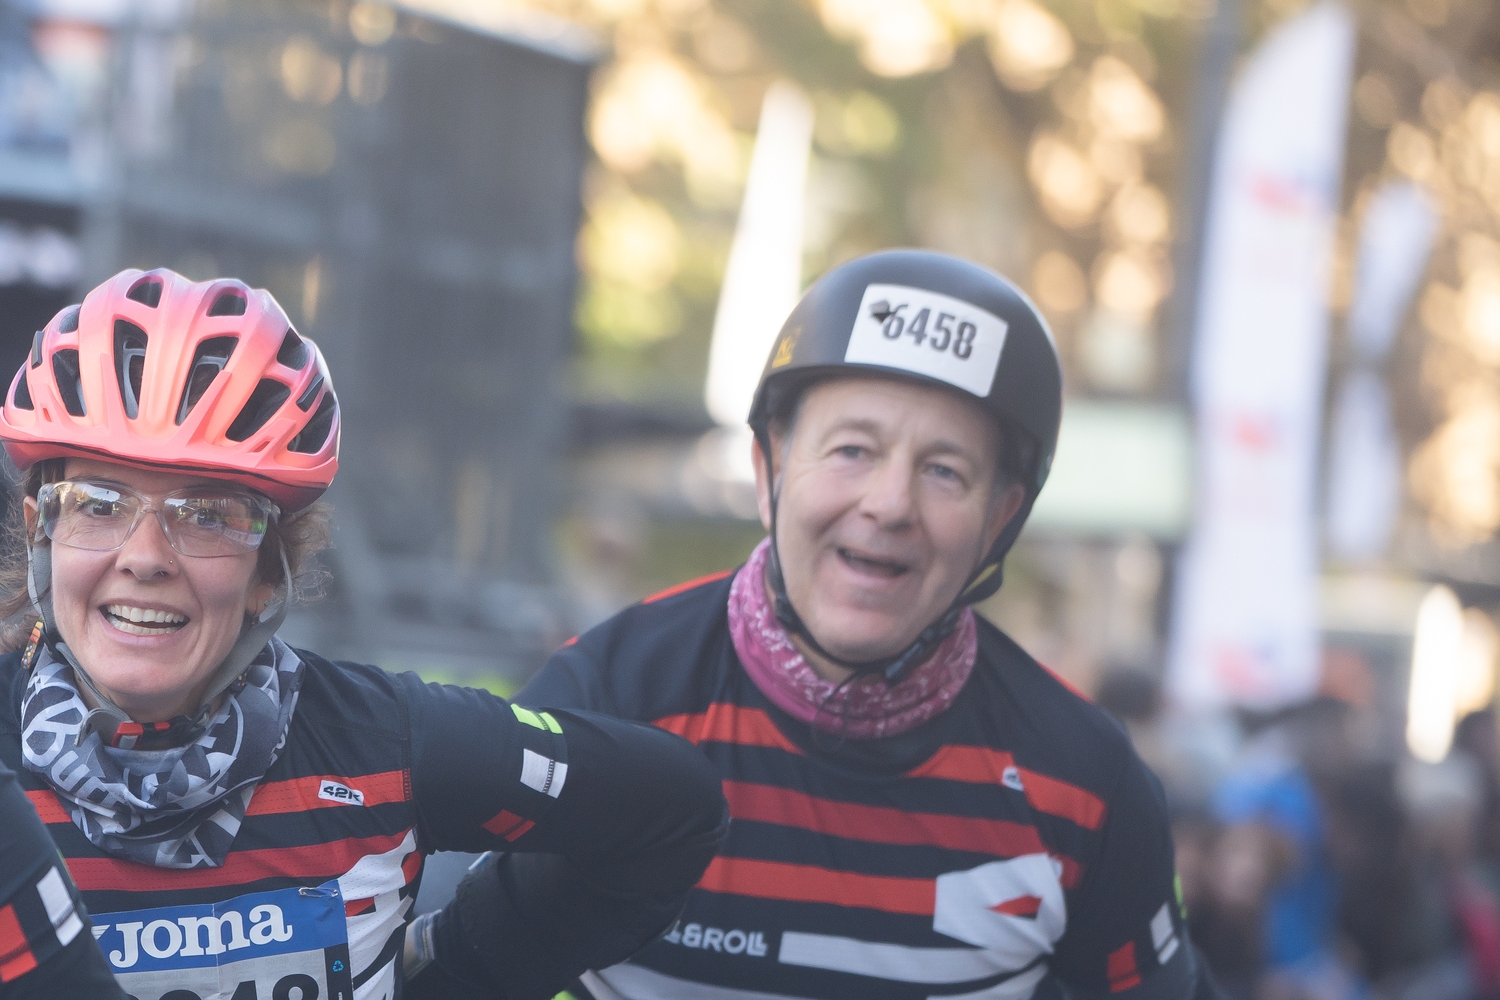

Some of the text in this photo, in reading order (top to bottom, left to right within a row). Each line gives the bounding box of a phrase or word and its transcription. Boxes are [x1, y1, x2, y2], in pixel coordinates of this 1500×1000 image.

[882, 303, 977, 361] 6458
[323, 785, 360, 802] 42K
[109, 904, 293, 968] Joma
